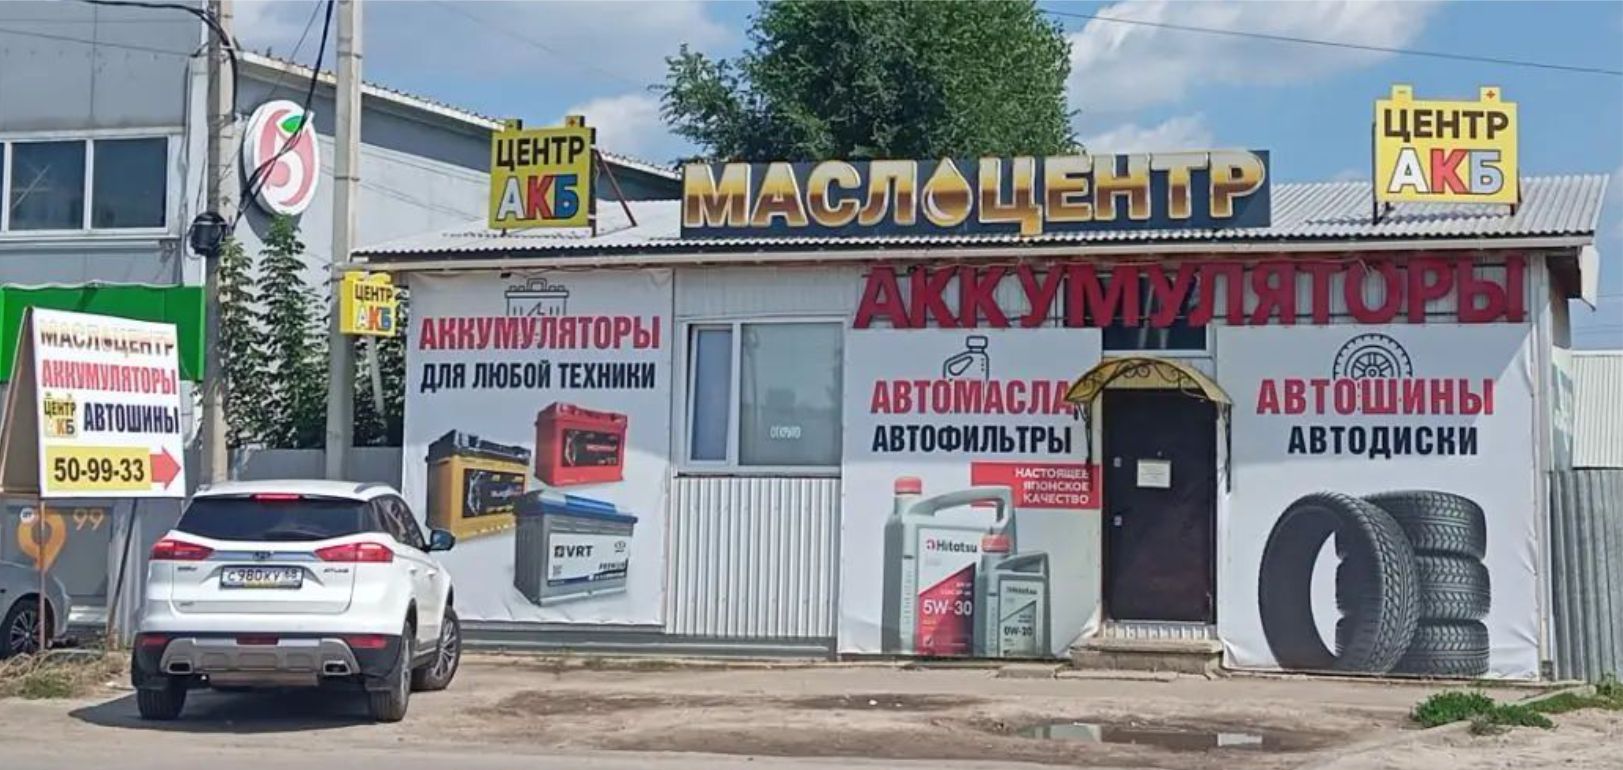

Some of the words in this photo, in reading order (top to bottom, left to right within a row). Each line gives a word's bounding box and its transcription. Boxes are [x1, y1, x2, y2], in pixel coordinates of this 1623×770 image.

[1384, 109, 1508, 142] ЦЕНТР
[496, 136, 584, 171] ЦЕНТР
[1387, 148, 1504, 194] АКБ
[495, 174, 579, 221] АКБ
[354, 284, 394, 302] ЦЕНТР
[853, 257, 1526, 328] АККУМУЛЯТОРЫ
[356, 305, 393, 330] АКБ
[419, 316, 660, 350] АККУМУЛЯТОРЫ
[42, 358, 177, 395] АККУМУЛЯТОРЫ
[420, 363, 465, 393] ДЛЯ
[472, 360, 551, 389] ЛЮБОЙ
[557, 362, 656, 389] ТЕХНИКИ
[44, 400, 77, 418] ЦЕНТР
[870, 380, 1075, 415] АВТОМАСЛА
[1256, 378, 1494, 416] АВТОШИНЫ
[83, 402, 179, 434] АВТОШИНЫ
[871, 425, 1072, 453] АВТОФИЛЬТРЫ
[1287, 425, 1478, 460] АВТОДИСКИ
[53, 457, 145, 482] 50-99-33
[1015, 468, 1089, 479] НАСТОЯЩЕЕ
[1023, 481, 1089, 491] ЯПОНСКОЕ
[1023, 493, 1089, 504] КАЧЕСТВО
[567, 545, 594, 557] VRT
[937, 539, 978, 553] Hitotsu
[922, 600, 973, 616] 5W-30
